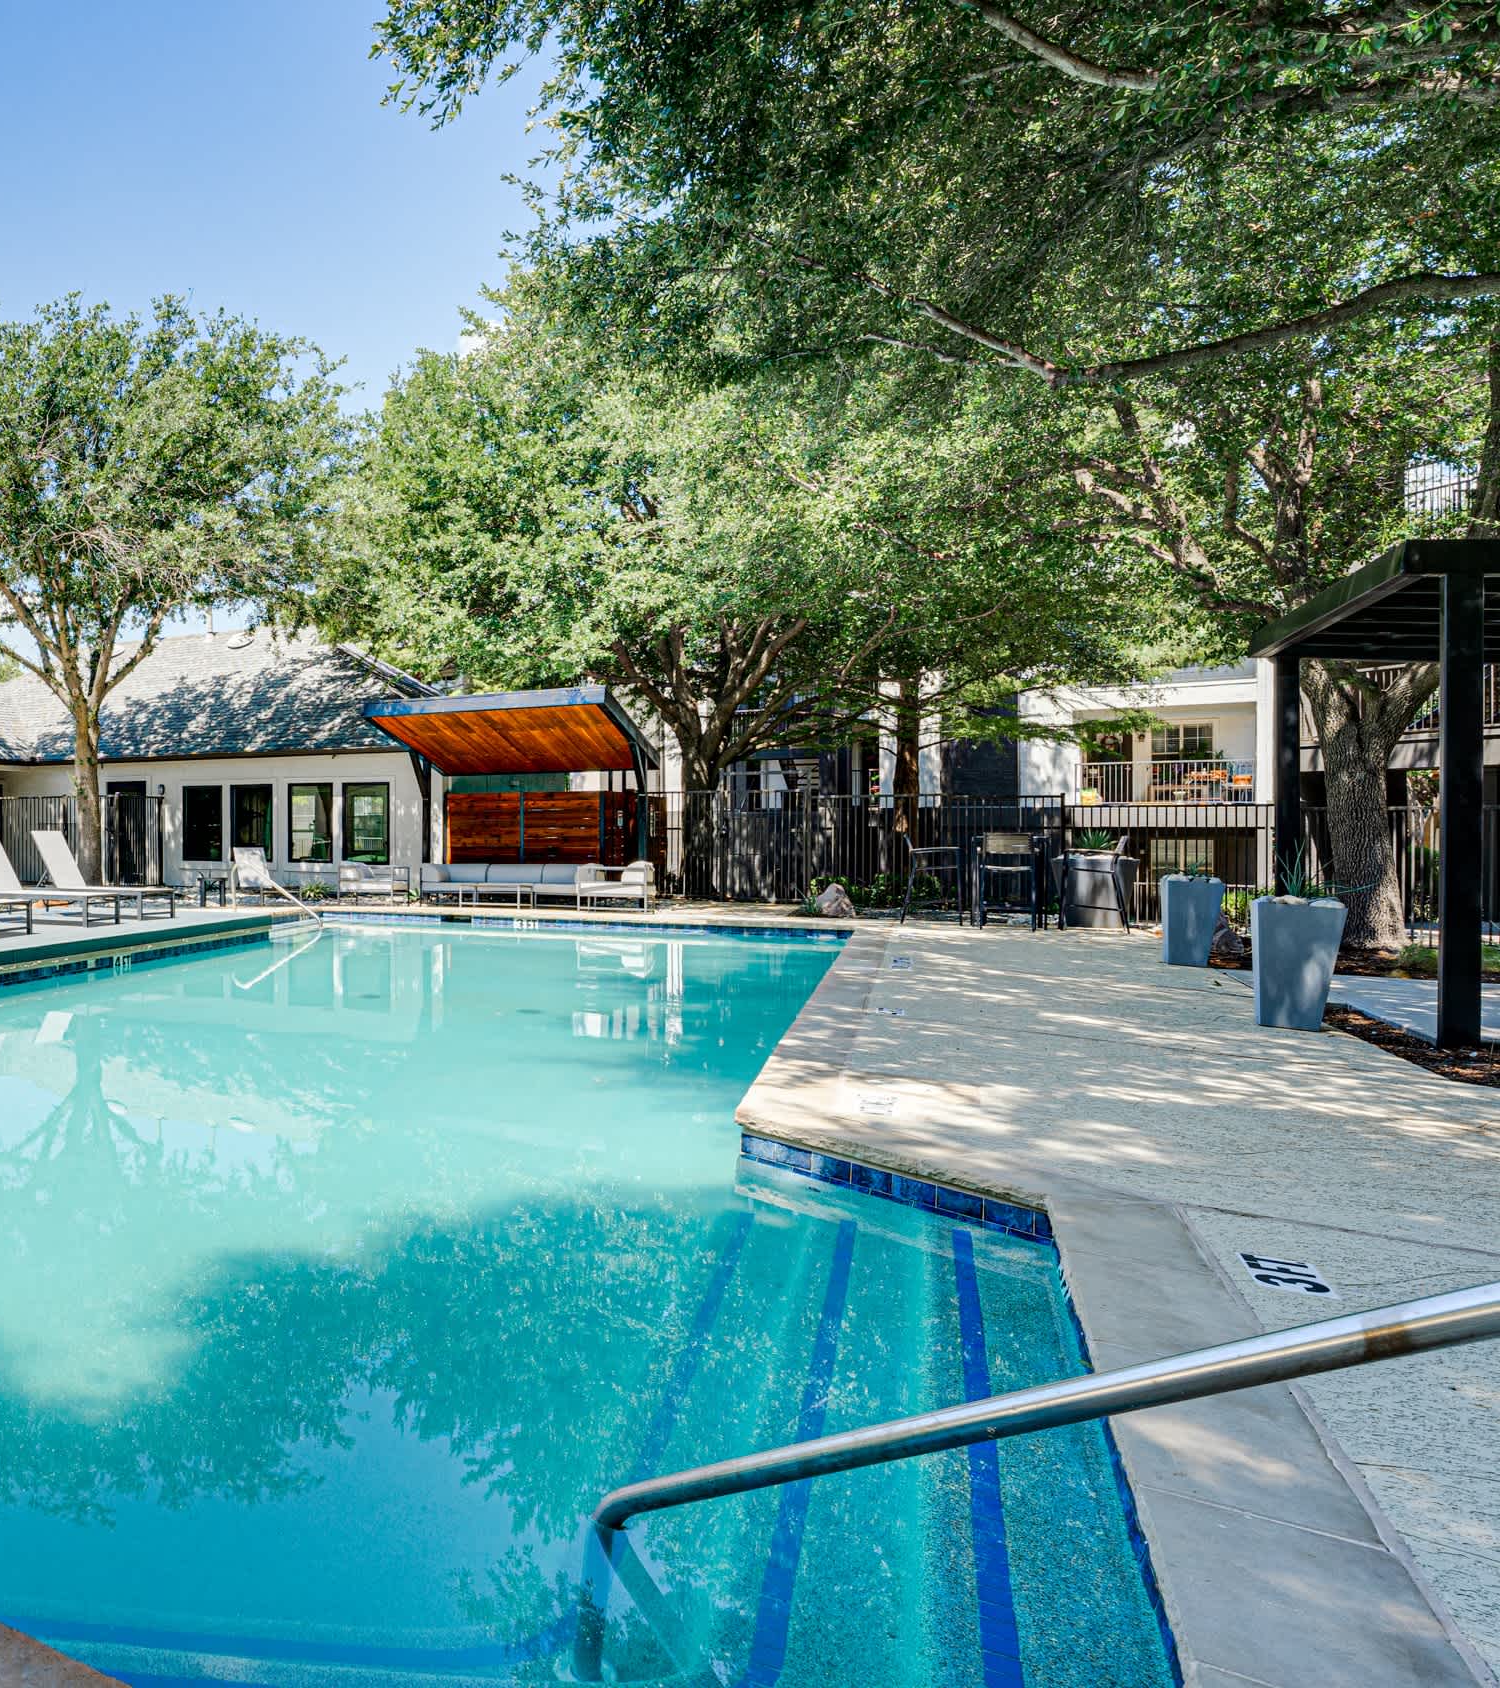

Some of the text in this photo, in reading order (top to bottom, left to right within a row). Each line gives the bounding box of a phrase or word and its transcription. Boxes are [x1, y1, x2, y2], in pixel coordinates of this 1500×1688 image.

[526, 920, 537, 928] FT
[115, 955, 130, 968] 4 FT
[1240, 1253, 1330, 1293] 3 FT
